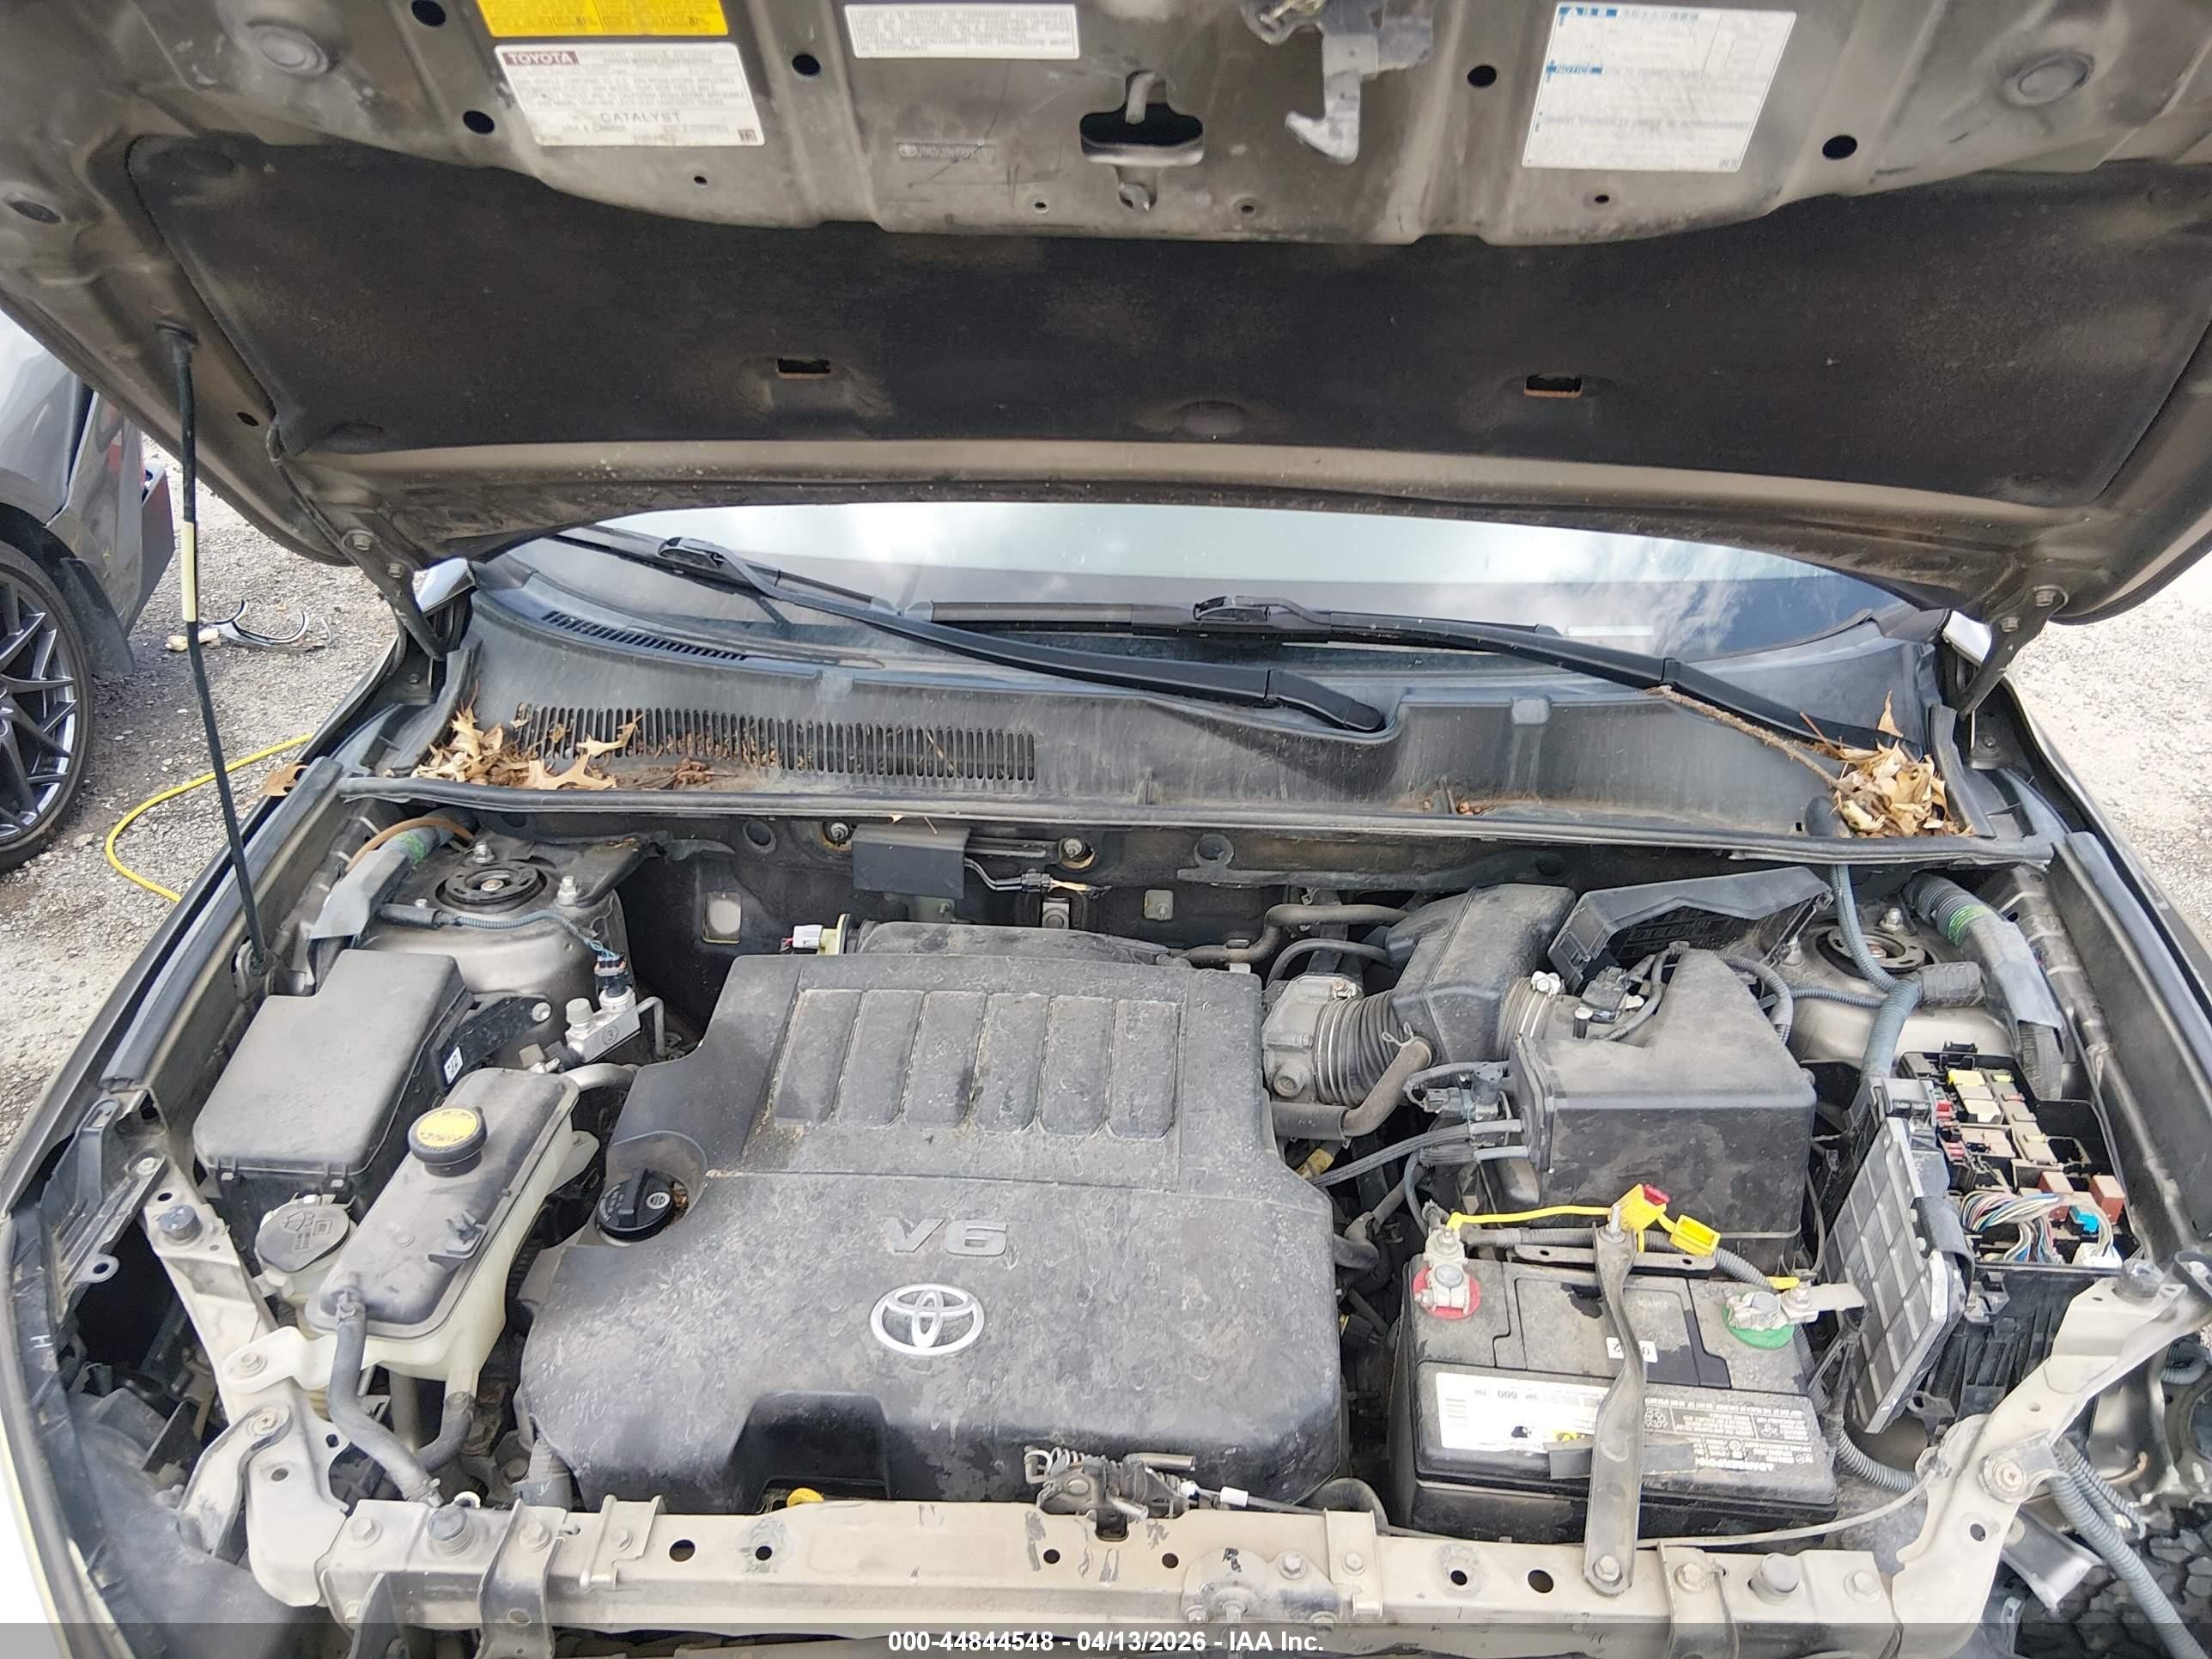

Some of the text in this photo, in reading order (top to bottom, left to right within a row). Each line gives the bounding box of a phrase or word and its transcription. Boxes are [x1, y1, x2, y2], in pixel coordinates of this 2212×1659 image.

[509, 52, 574, 65] TOYOTA
[600, 111, 682, 124] CATALYST
[879, 1217, 1008, 1257] V6
